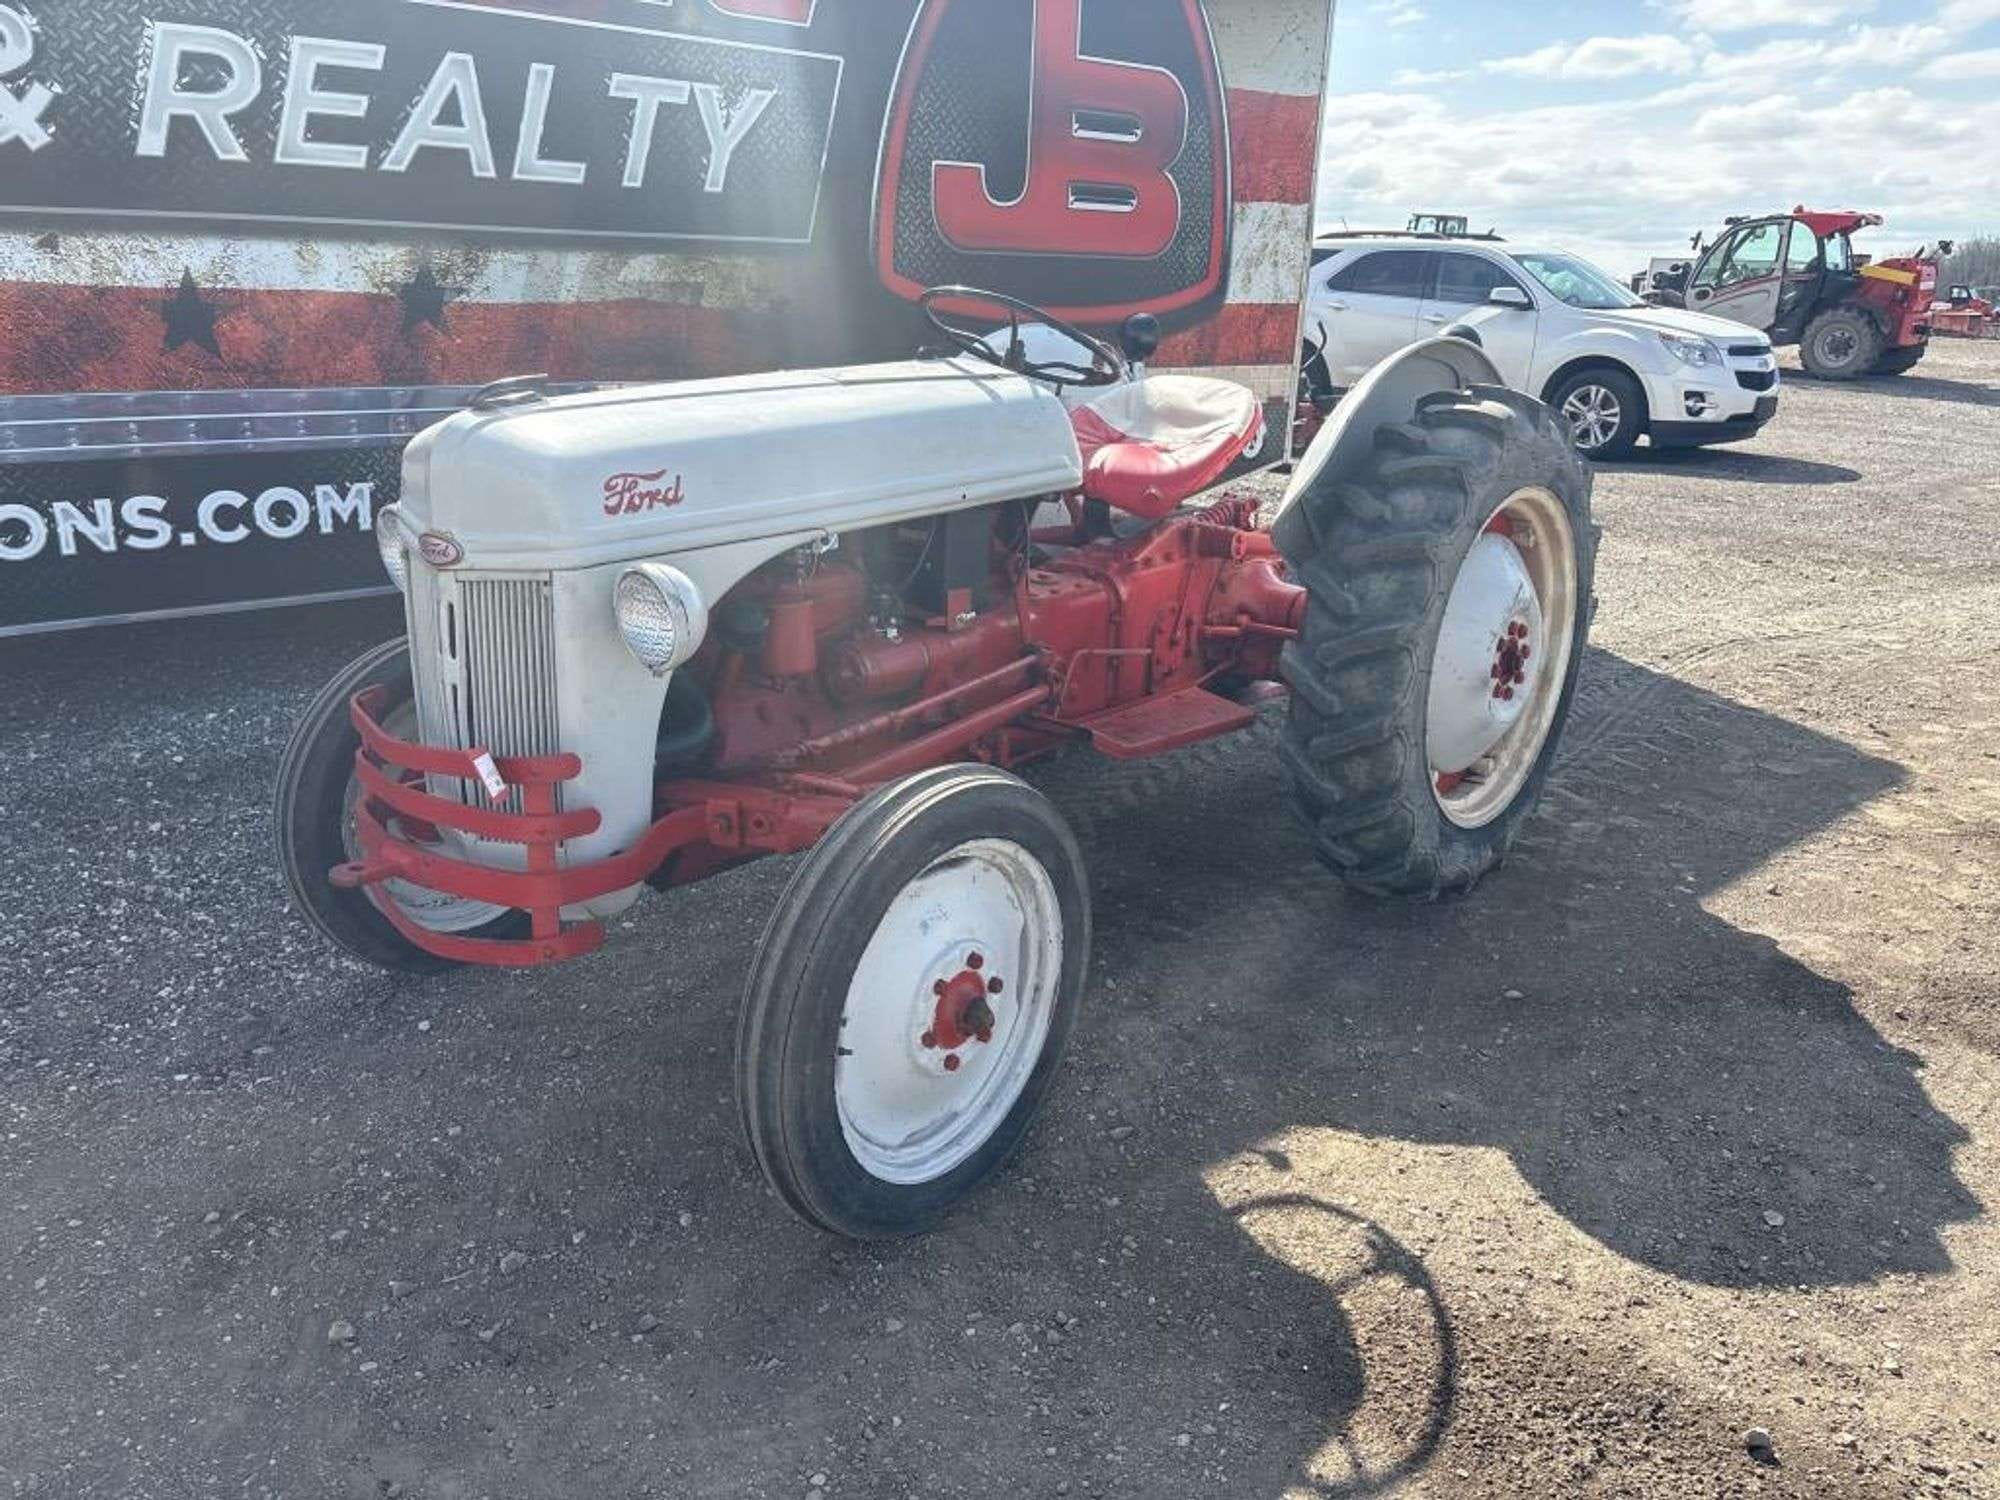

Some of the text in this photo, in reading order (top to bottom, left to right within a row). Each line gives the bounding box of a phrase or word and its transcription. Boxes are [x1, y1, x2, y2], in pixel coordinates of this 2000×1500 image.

[134, 20, 778, 193] REALTY
[931, 0, 1188, 258] JB
[0, 482, 374, 561] ONS.COM
[603, 468, 685, 516] Ford
